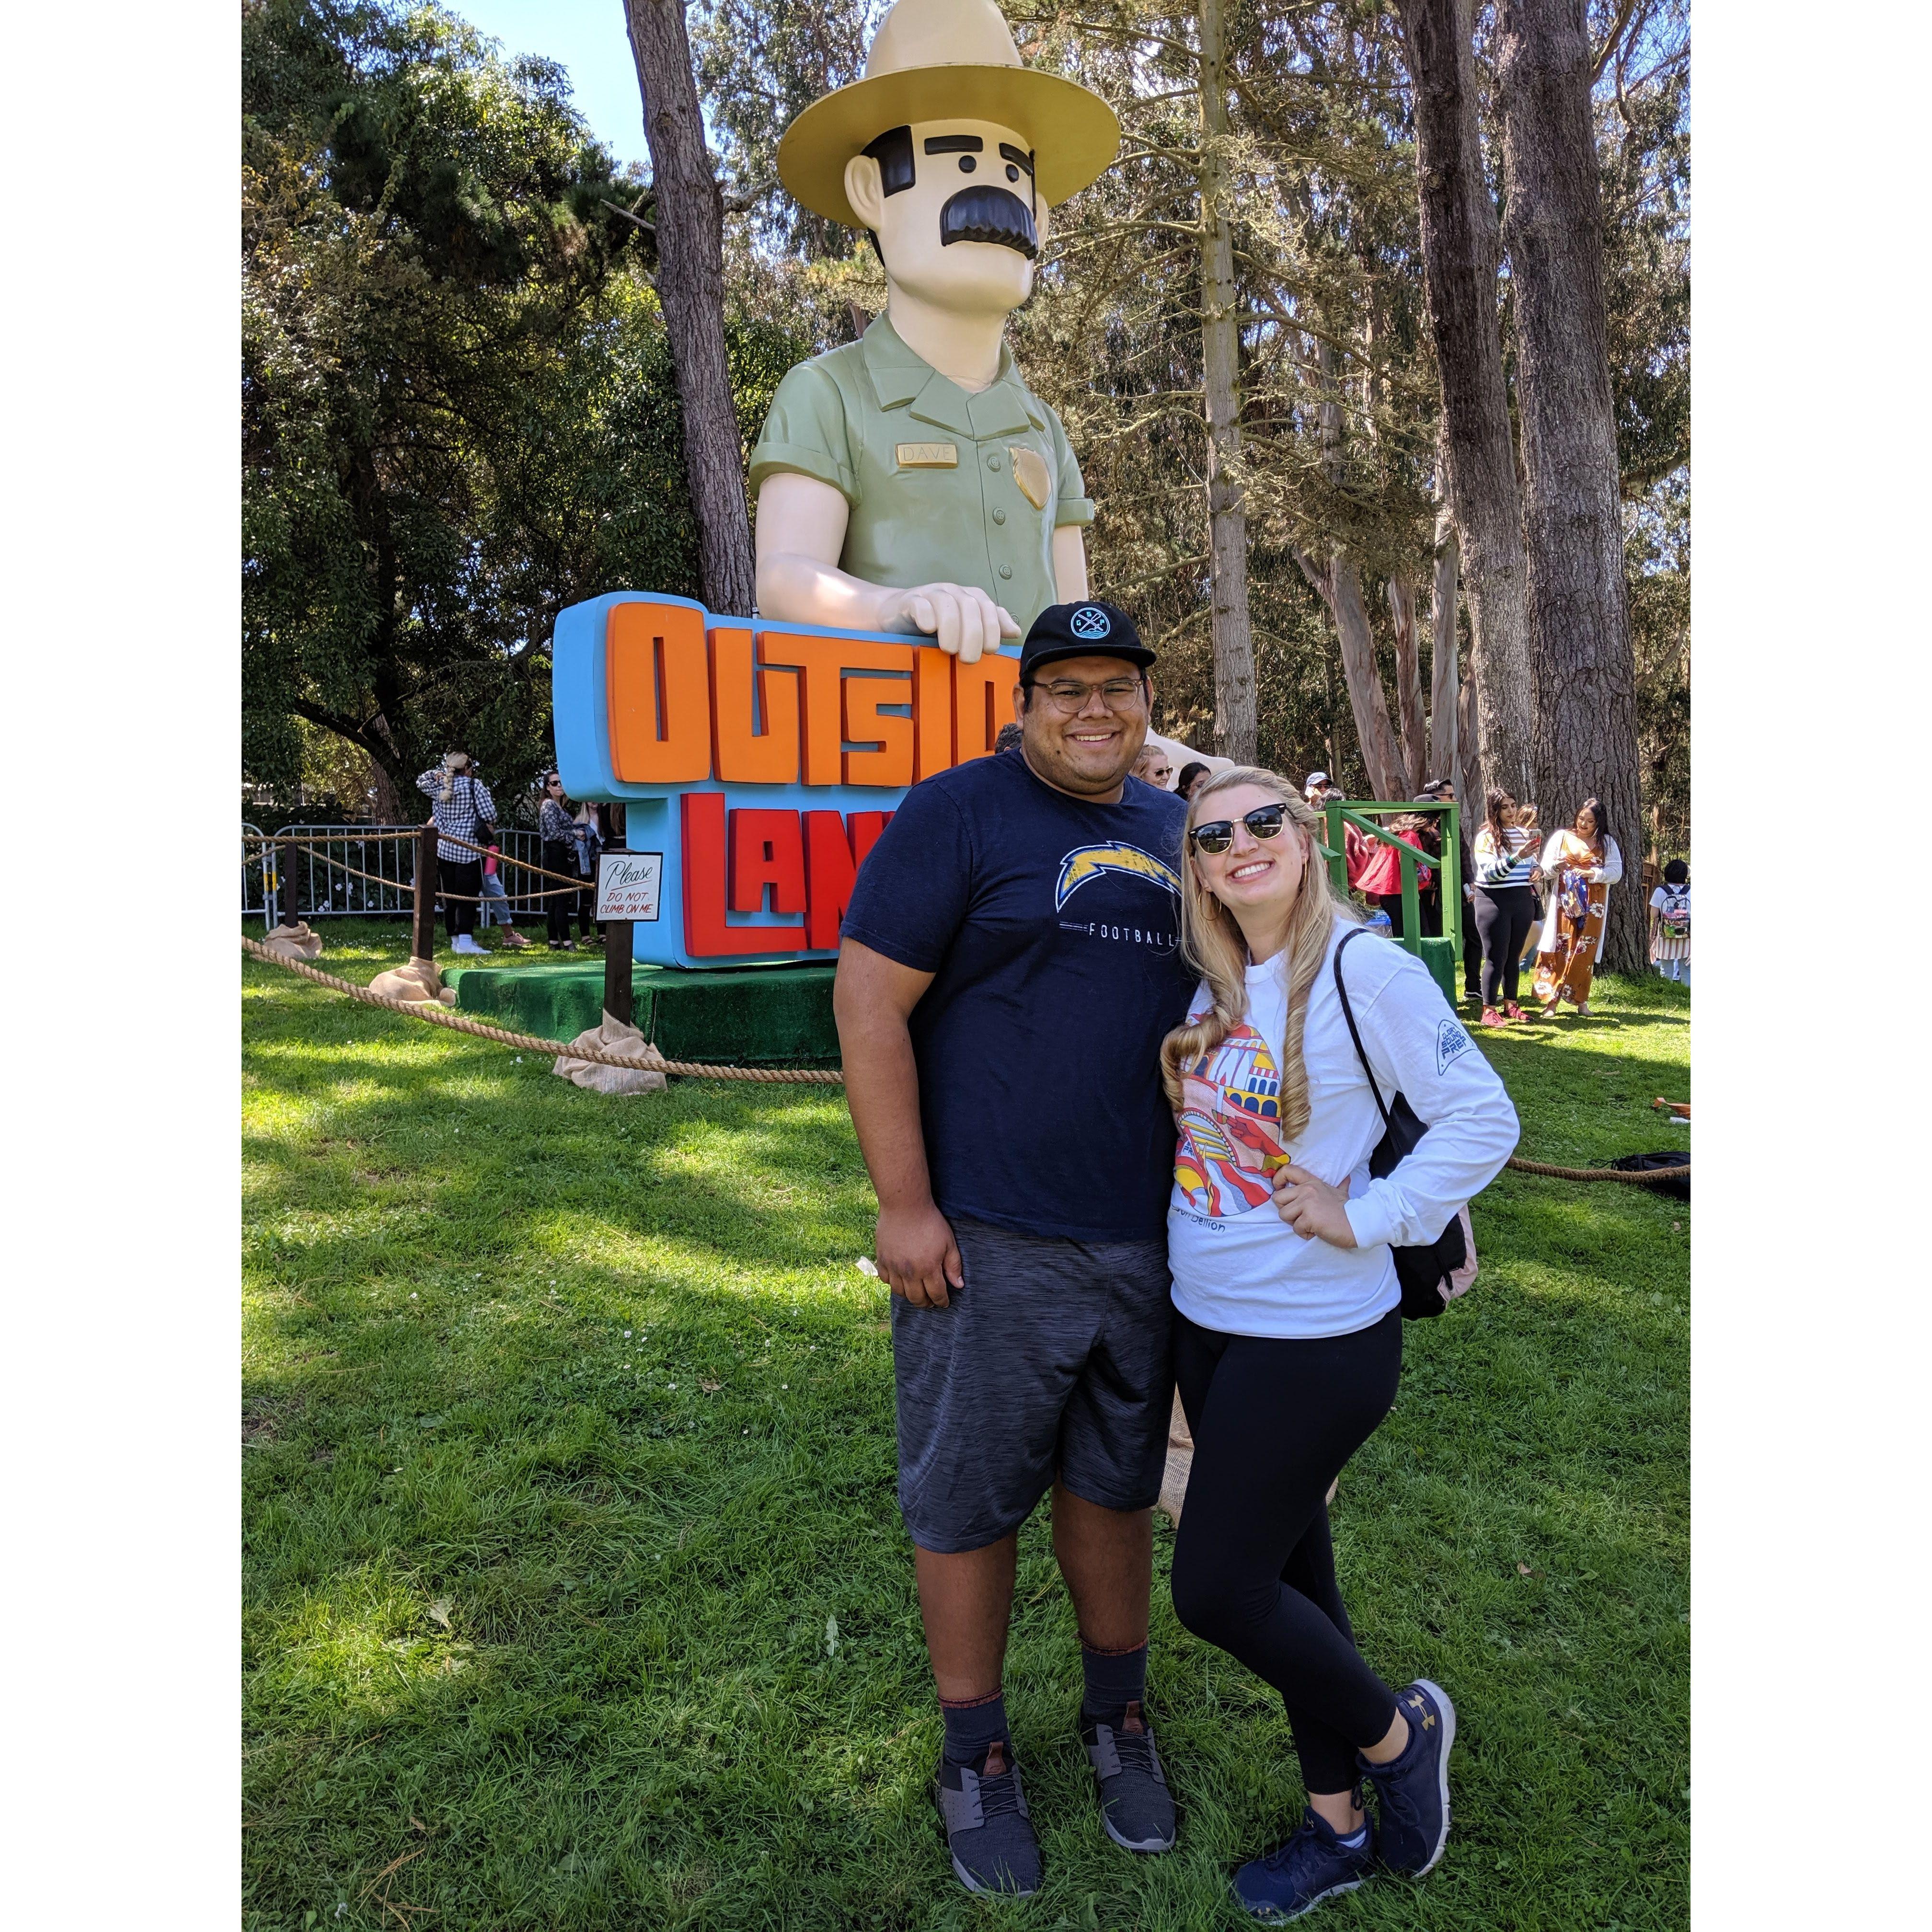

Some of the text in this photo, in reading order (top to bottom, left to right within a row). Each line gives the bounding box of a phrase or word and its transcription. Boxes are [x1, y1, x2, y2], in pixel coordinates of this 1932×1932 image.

[903, 446, 953, 461] DAVE
[605, 861, 653, 890] Please
[680, 793, 896, 956] LAN
[606, 892, 649, 902] DO NOT
[600, 904, 654, 914] CLIMB ON ME
[1089, 922, 1174, 947] FOOTBALL
[1441, 1031, 1461, 1048] SOUND
[1441, 1035, 1467, 1060] PREP
